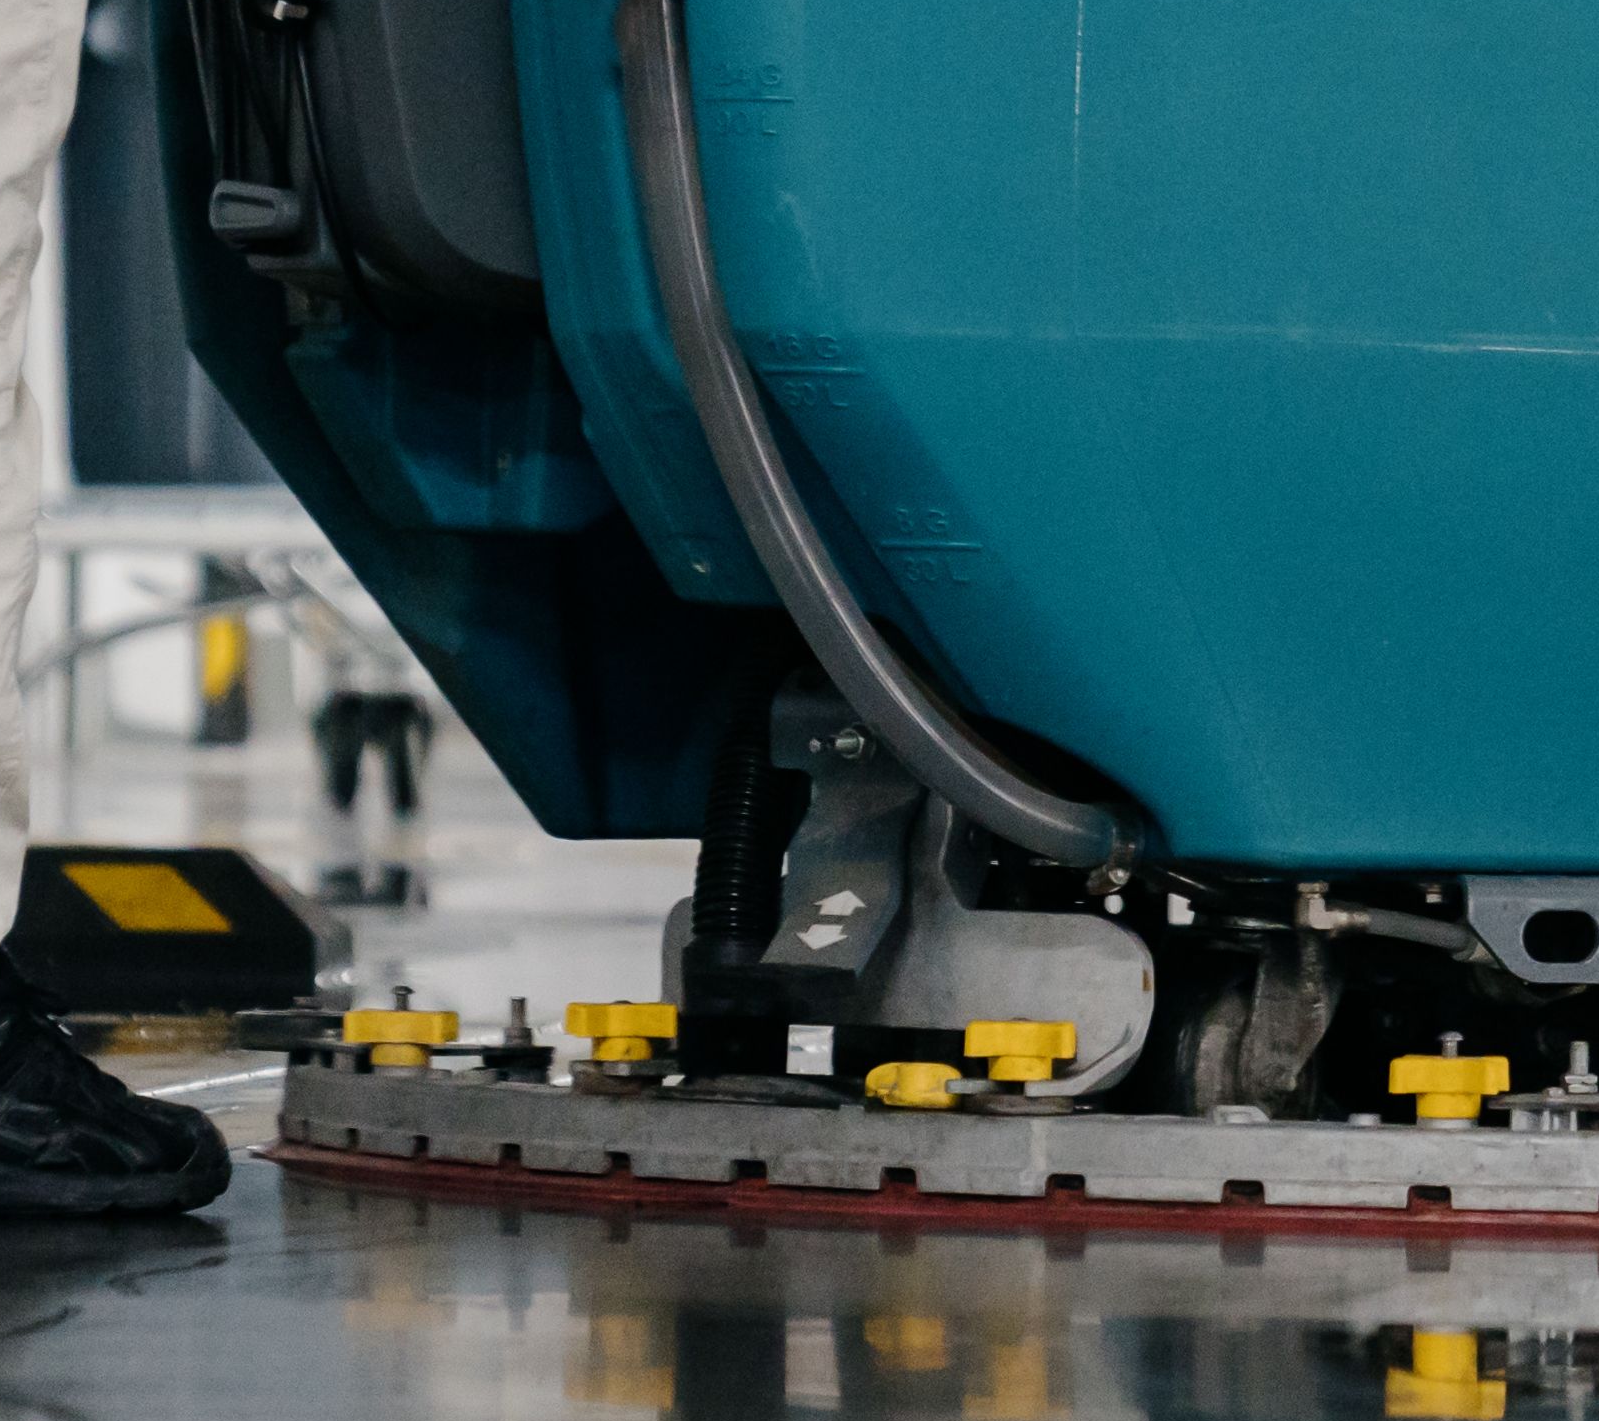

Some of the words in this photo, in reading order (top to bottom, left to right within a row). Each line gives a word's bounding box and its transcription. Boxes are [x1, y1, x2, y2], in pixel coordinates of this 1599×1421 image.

[756, 61, 783, 89] G
[758, 109, 781, 137] L
[814, 331, 842, 360] G
[822, 380, 850, 410] L
[922, 506, 950, 536] G
[942, 555, 972, 585] L
